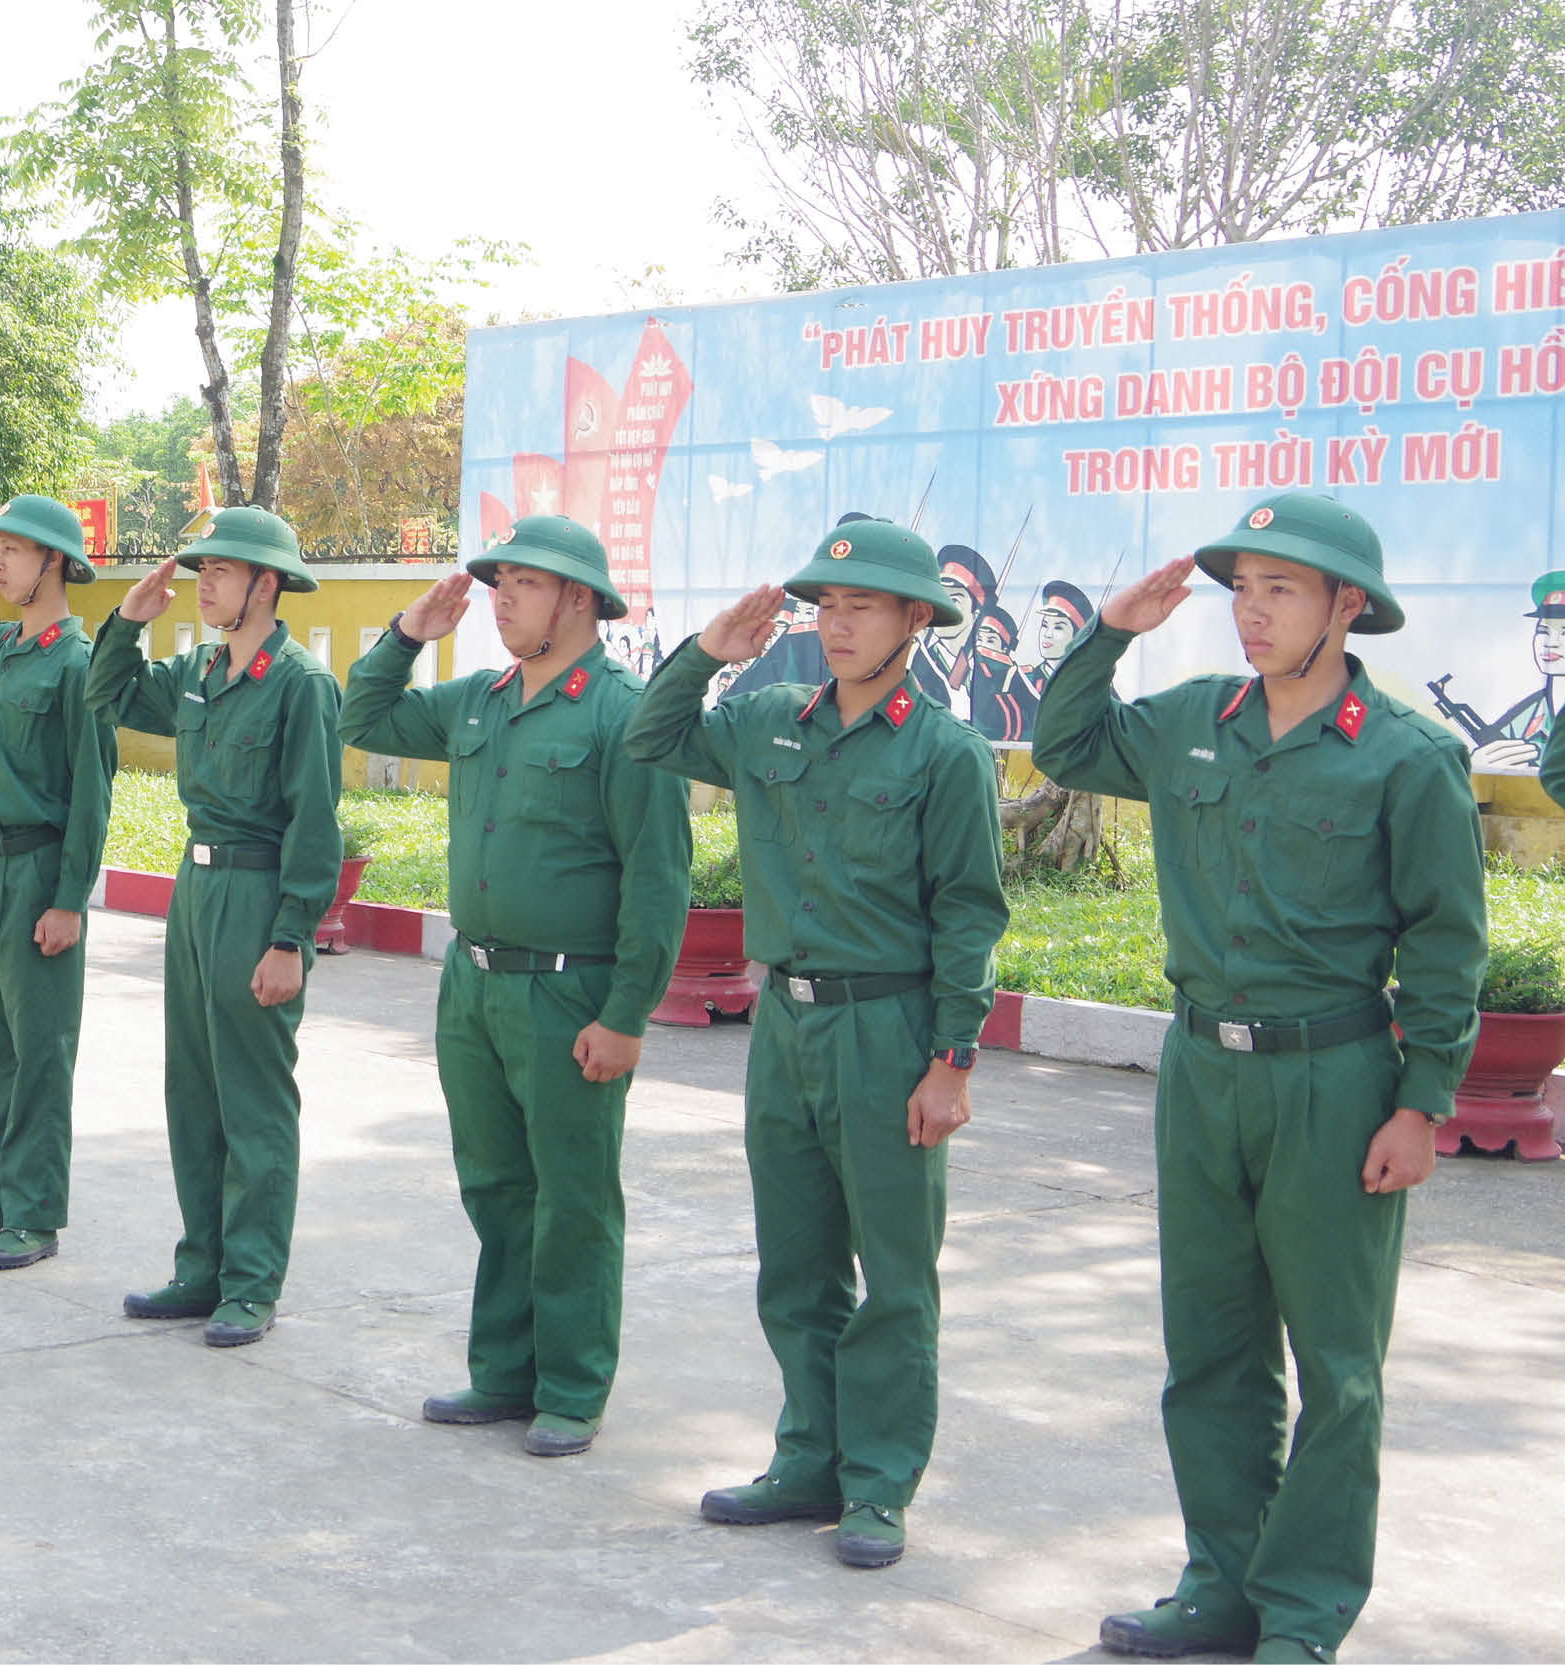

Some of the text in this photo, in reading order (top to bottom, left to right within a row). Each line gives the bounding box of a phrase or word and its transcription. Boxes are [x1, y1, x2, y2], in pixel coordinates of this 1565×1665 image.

[920, 314, 993, 361] HUY
[1002, 287, 1155, 354] TRUYỀN
[1168, 272, 1328, 338] THỐNG,
[1342, 255, 1477, 324] CỐNG
[995, 371, 1104, 425] XỨNG
[1116, 366, 1232, 417] DANH
[1246, 353, 1306, 417] BỘ
[1319, 347, 1400, 414] ĐỘI
[1416, 349, 1484, 408] CỤ
[1063, 421, 1501, 495] TRONG THỜI KỲ MỚI
